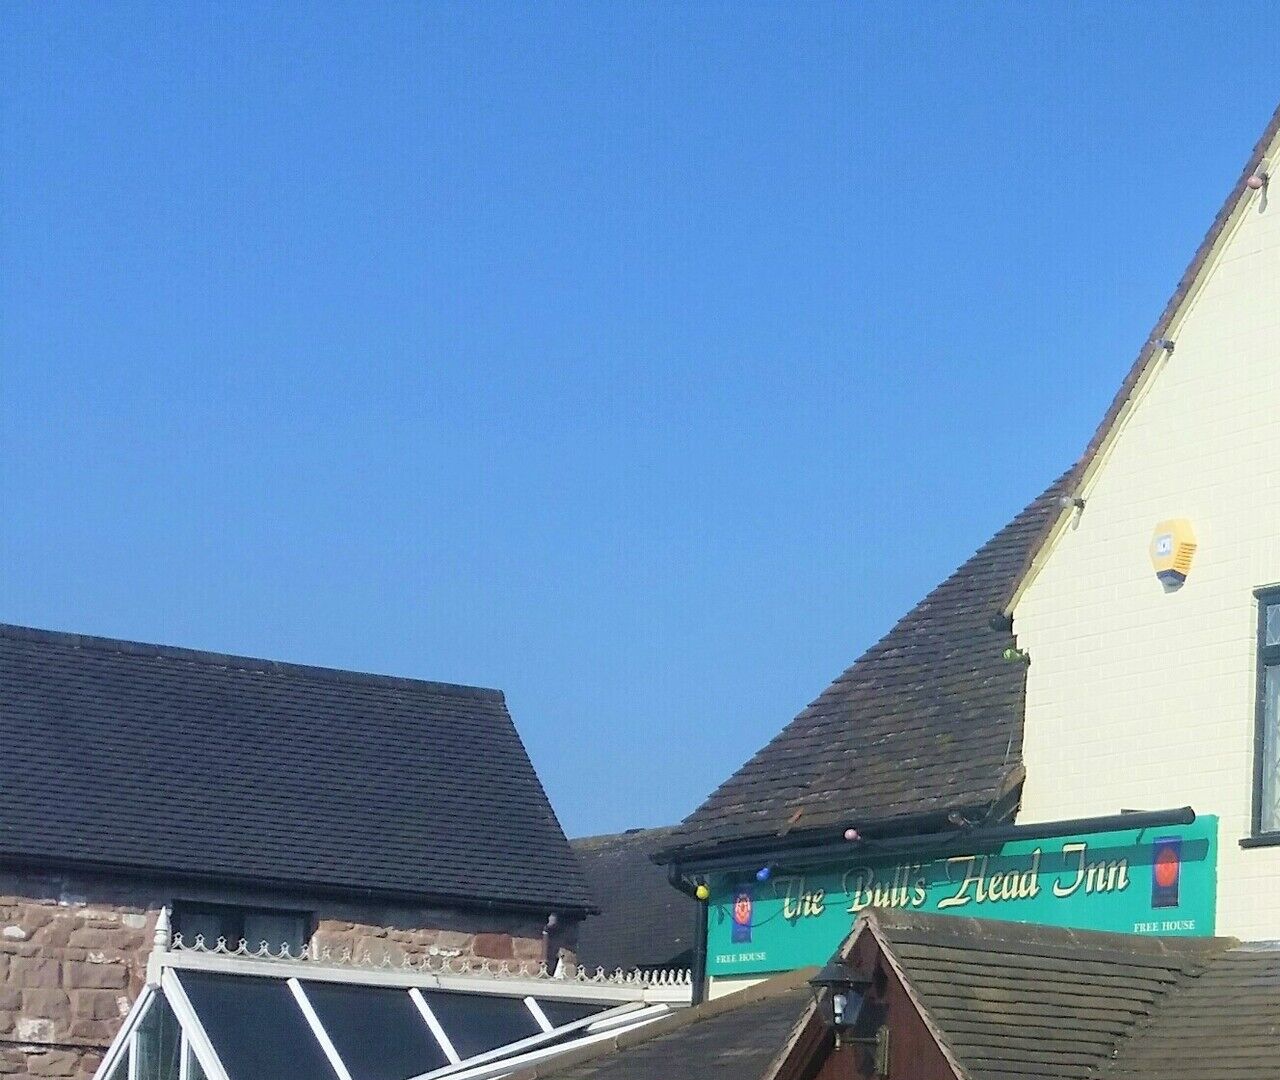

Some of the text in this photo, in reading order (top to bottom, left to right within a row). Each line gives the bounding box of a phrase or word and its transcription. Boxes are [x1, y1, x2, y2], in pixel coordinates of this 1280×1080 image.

[771, 842, 1130, 919] The Bull's Head Inn
[1134, 920, 1195, 932] FREE HOUSE
[716, 952, 767, 964] FREE HOUSE
